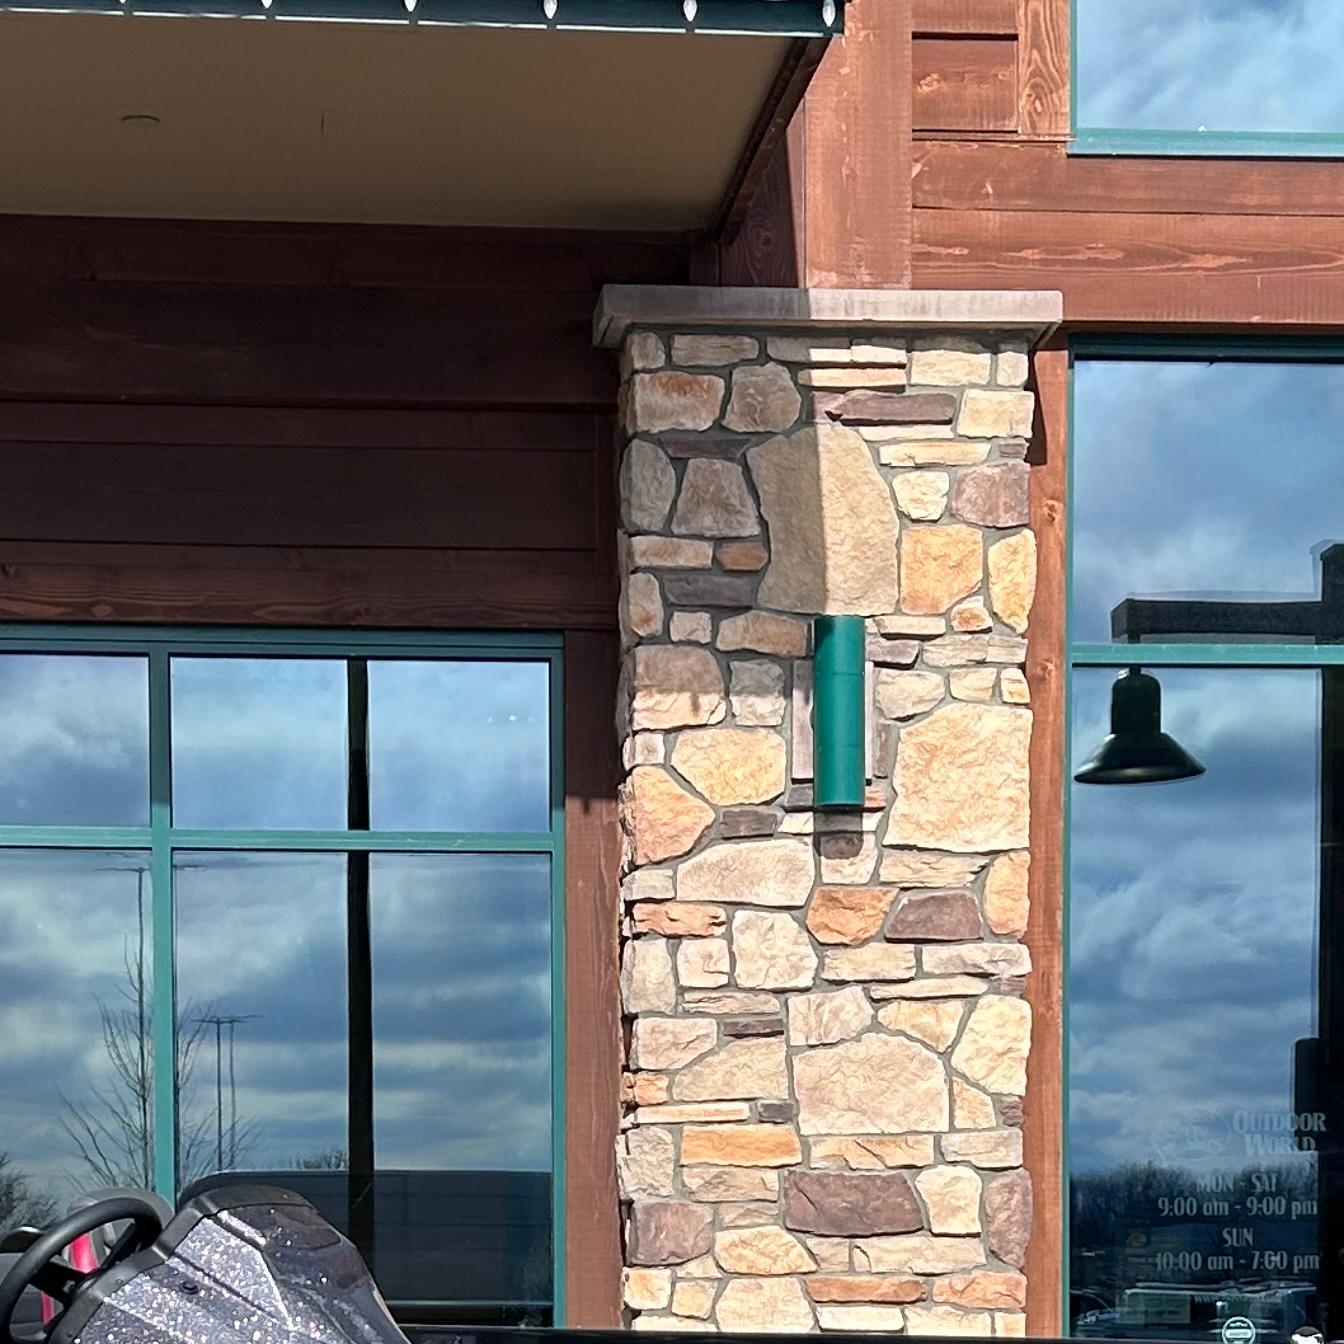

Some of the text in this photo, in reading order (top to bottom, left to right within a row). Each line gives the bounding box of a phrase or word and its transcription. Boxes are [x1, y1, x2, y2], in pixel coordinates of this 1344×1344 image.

[1251, 1173, 1279, 1193] SAT
[1158, 1197, 1197, 1216] 9:00
[1203, 1202, 1229, 1216] am
[1246, 1196, 1286, 1216] 9:00
[1291, 1201, 1318, 1220] pm
[1222, 1227, 1254, 1247] SUN
[1156, 1251, 1202, 1271] 10:00
[1207, 1255, 1233, 1270] am
[1251, 1250, 1287, 1270] 7:00
[1293, 1254, 1320, 1273] pm
